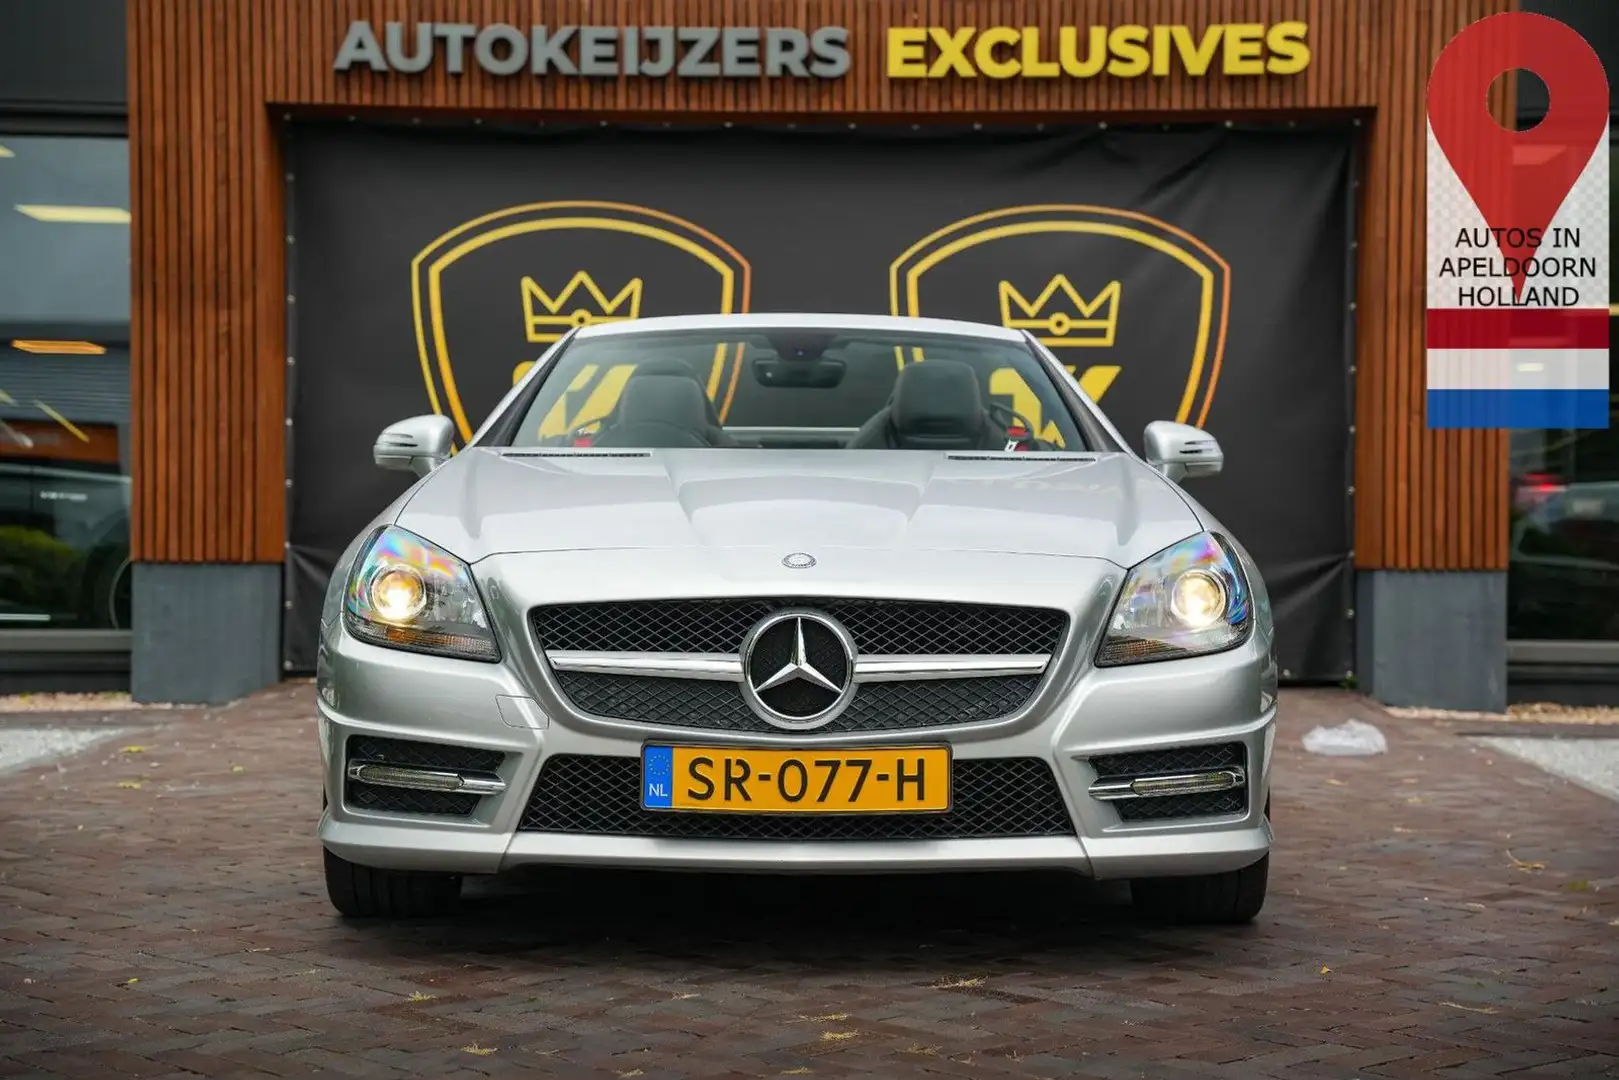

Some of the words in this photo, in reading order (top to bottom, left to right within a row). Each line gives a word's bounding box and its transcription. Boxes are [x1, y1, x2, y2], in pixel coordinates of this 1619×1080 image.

[333, 20, 851, 79] AUTOKEIJZERS
[887, 21, 1311, 80] EXCLUSIVES
[648, 783, 668, 798] NL
[687, 756, 925, 803] SR-077-H
